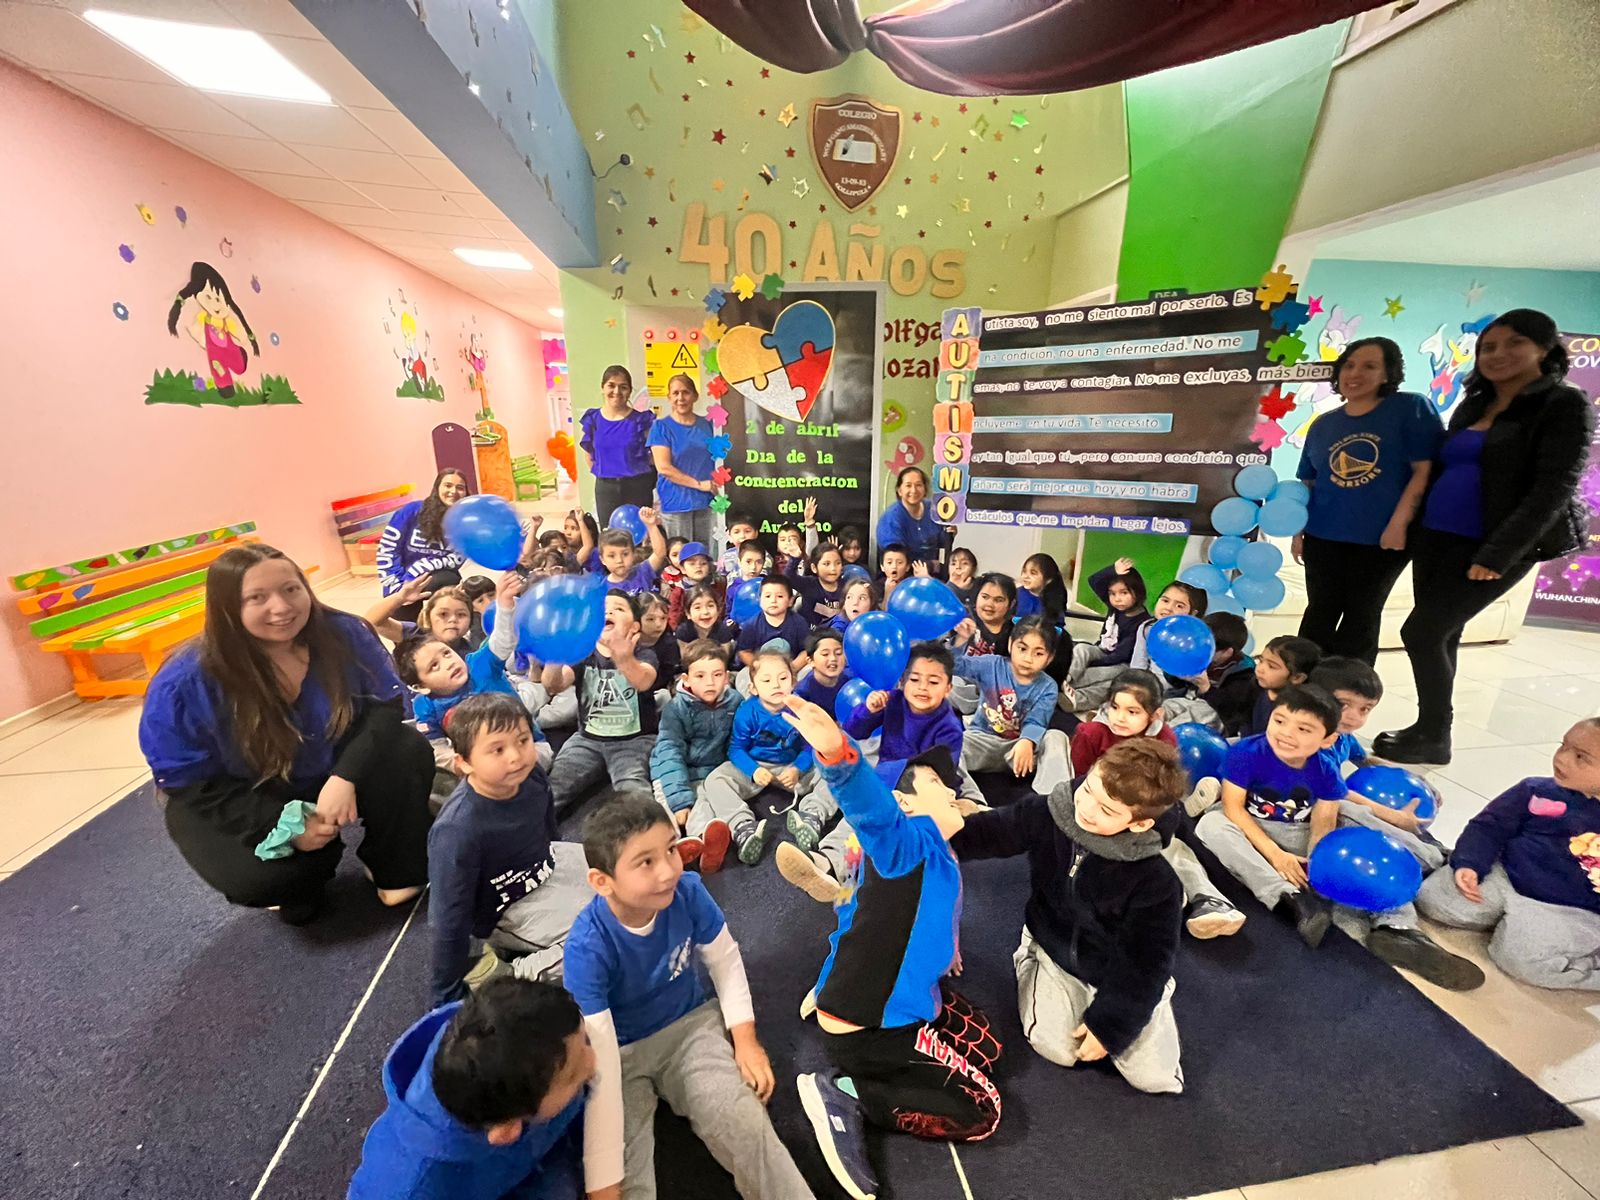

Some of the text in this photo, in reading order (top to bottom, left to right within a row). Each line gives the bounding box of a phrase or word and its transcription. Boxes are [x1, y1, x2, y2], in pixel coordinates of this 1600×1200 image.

[838, 109, 878, 120] COLEGIO
[679, 202, 967, 299] 40 AÑOS
[1046, 314, 1063, 325] no
[1064, 312, 1083, 322] me
[1088, 307, 1127, 321] siento
[1131, 302, 1156, 316] mal
[1160, 300, 1186, 315] por
[1235, 291, 1252, 305] Es
[1059, 348, 1074, 358] no
[1077, 347, 1100, 358] una
[1105, 340, 1188, 356] enfermedad.
[1193, 337, 1214, 350] No
[1217, 335, 1241, 347] me
[1135, 373, 1155, 385] No
[1158, 373, 1180, 384] me
[1185, 368, 1251, 383] excluyas,
[1259, 365, 1291, 379] más
[1296, 363, 1333, 378] bien
[746, 420, 840, 437] 2 de abril
[1089, 417, 1102, 428] Te
[1105, 416, 1159, 428] necesito
[786, 449, 806, 463] de
[817, 450, 834, 464] la
[1033, 453, 1056, 464] que
[1081, 453, 1109, 464] pero
[1112, 453, 1135, 463] con
[1138, 453, 1162, 463] una
[1165, 451, 1233, 464] condición
[1236, 453, 1267, 465] que
[1034, 482, 1064, 494] mejor
[1094, 484, 1117, 496] hoy
[1130, 486, 1146, 495] no
[778, 499, 804, 514] del
[1039, 515, 1057, 525] me
[1062, 514, 1109, 527] impidan
[1113, 516, 1148, 530] llegar
